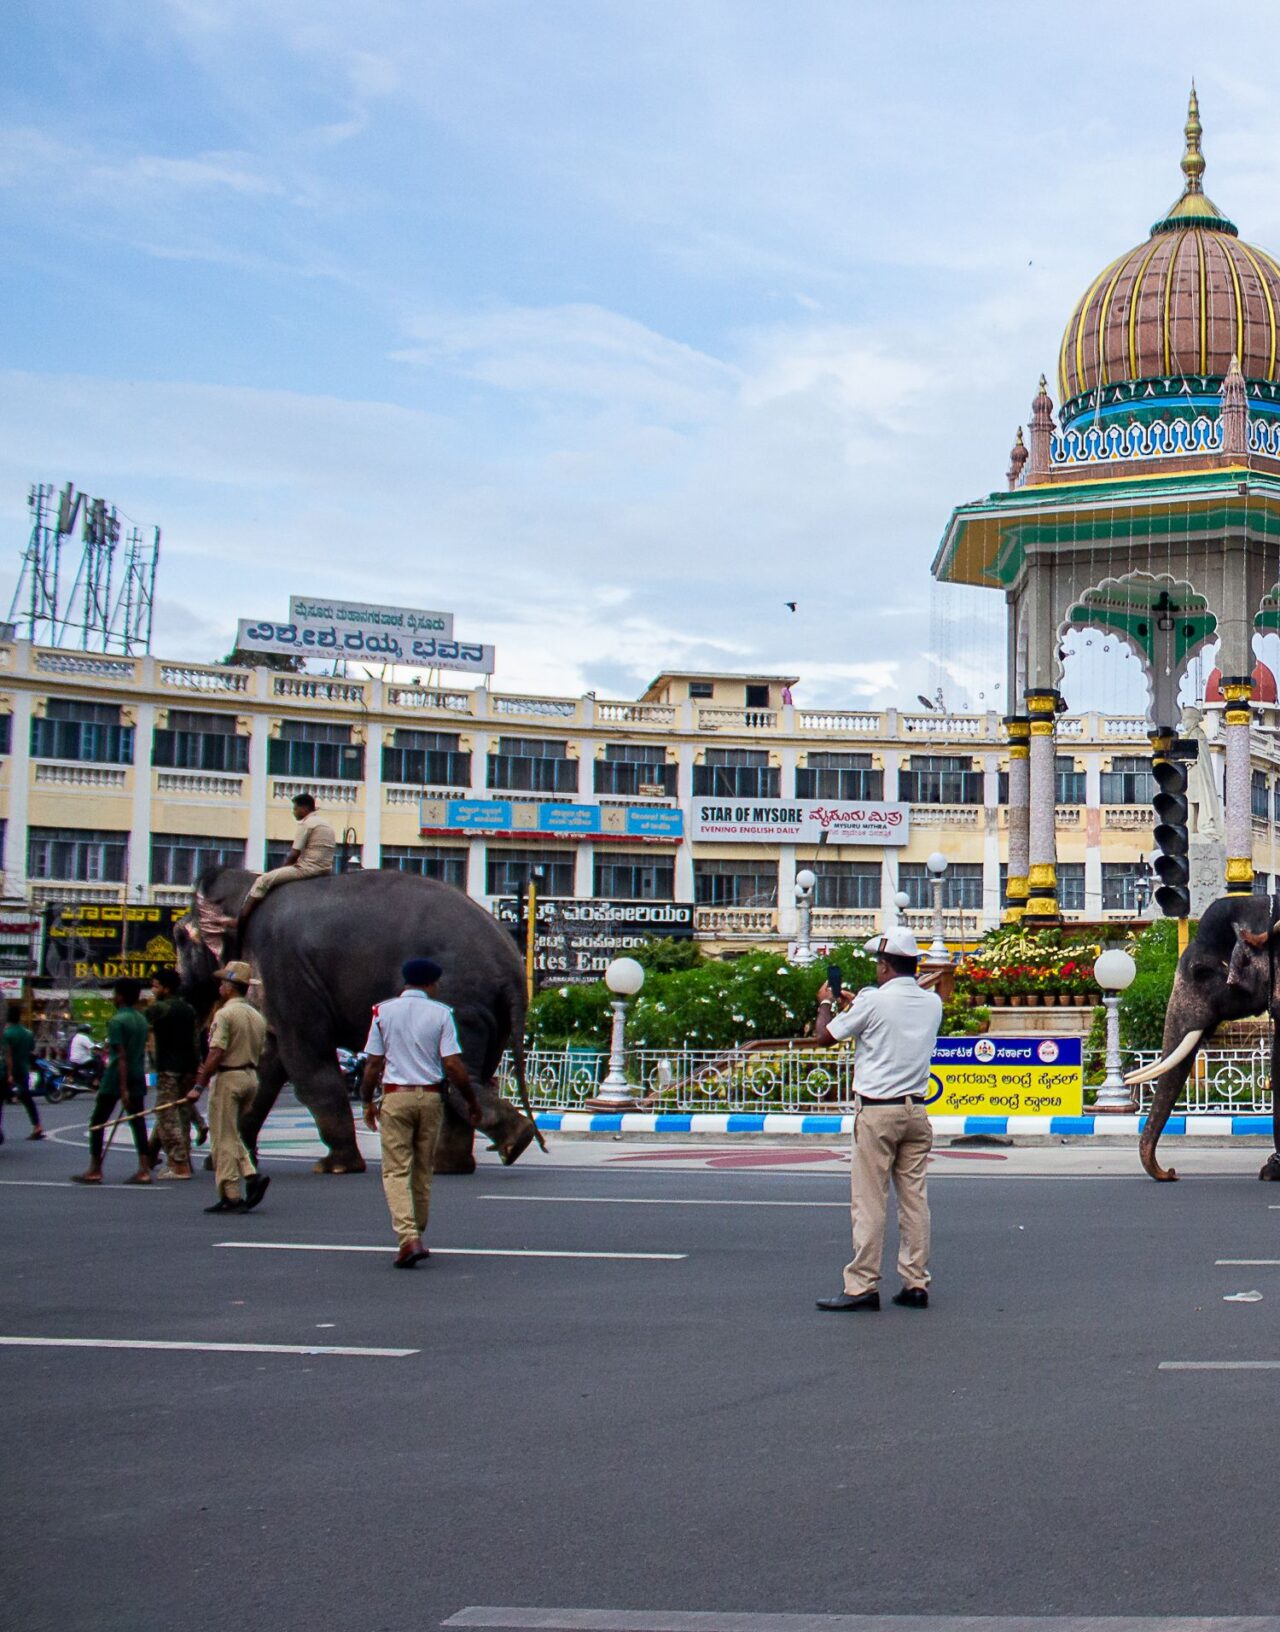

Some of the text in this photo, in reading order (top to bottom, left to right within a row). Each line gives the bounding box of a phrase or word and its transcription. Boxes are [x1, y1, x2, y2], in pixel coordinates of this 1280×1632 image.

[412, 638, 484, 661] ಭವನ
[701, 807, 803, 823] STAR OF MYSORE
[809, 807, 903, 827] ಮೈಸೂರು ಮಿತ್ರ
[701, 826, 737, 834] EVENING
[777, 827, 799, 835] DAILY
[76, 962, 157, 978] BADSHA
[946, 1073, 1078, 1088] ಅಗರಬತ್ತಿ ಅಂದ್ರೆ ಸೈಕಲ್
[946, 1094, 985, 1110] ಸೈಕಲ್
[989, 1094, 1020, 1110] ಅಂದ್ರೆ
